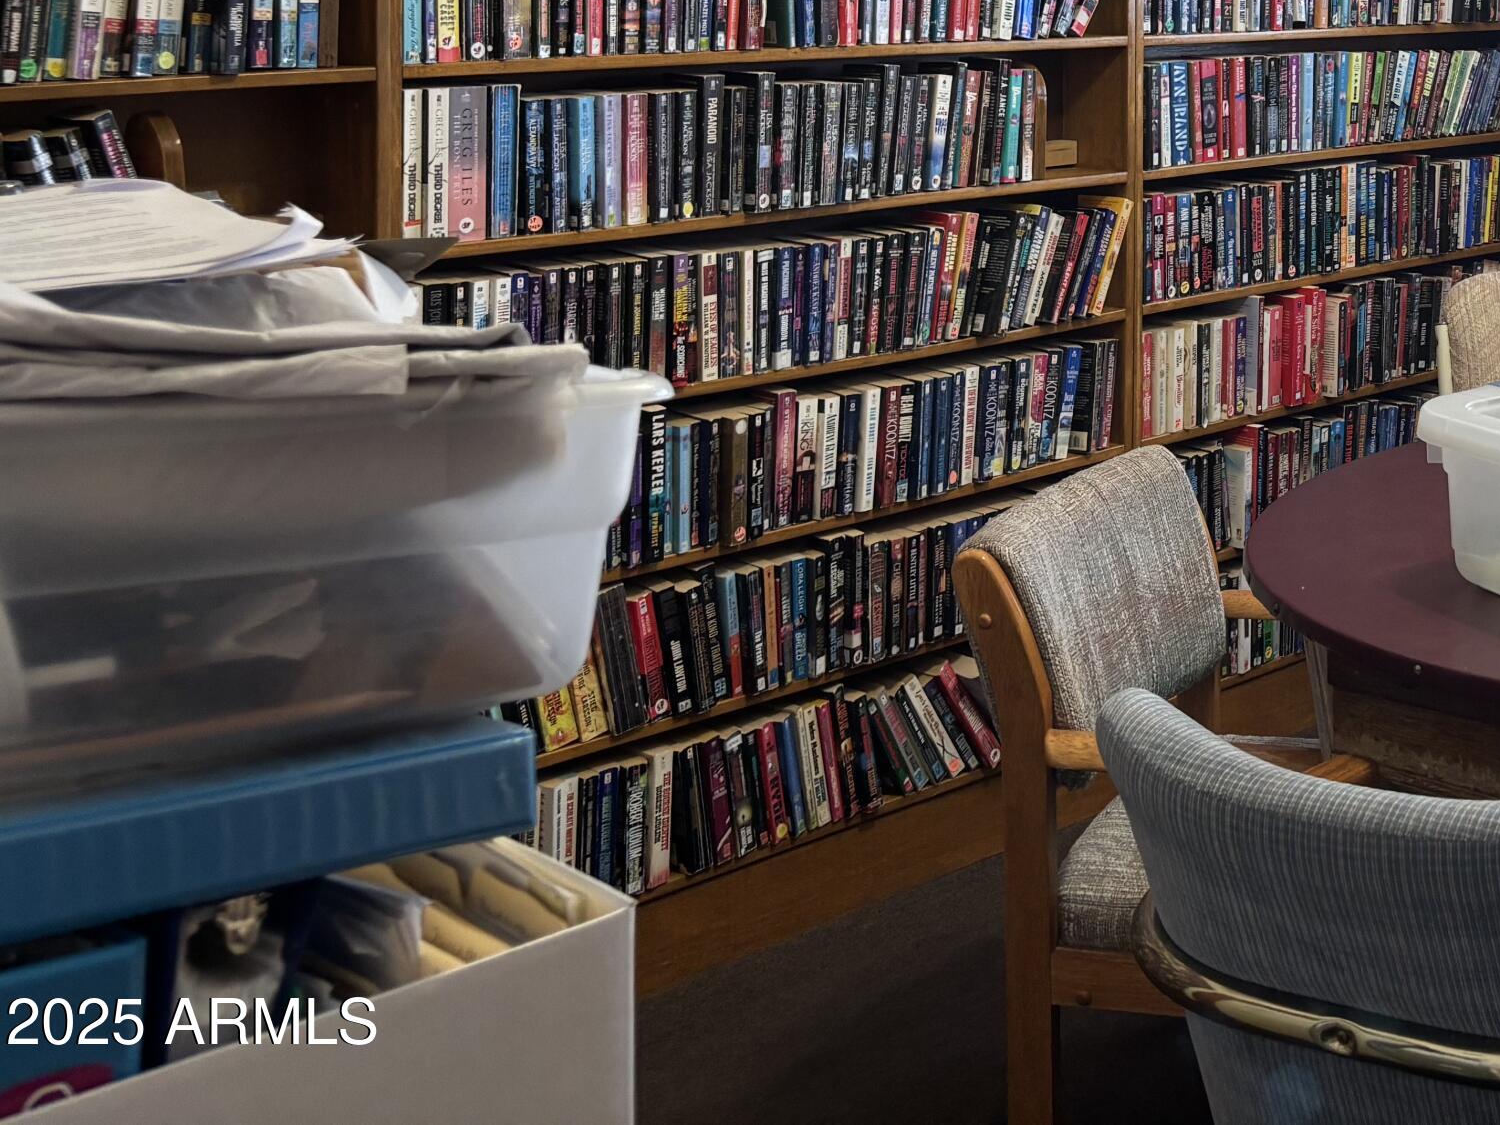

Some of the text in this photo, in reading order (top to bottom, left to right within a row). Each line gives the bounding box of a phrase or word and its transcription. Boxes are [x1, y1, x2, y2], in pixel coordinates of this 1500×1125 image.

[234, 3, 244, 47] THE CINDERELLA
[706, 97, 717, 144] PARANOID
[998, 91, 1006, 118] JANCE
[1174, 65, 1186, 149] AYN RAND
[434, 108, 444, 223] GREG ILES THIRD DEGREE
[461, 108, 472, 206] GREG ILES
[1031, 271, 1045, 313] MONSTER
[870, 298, 880, 343] EXPOSED
[983, 395, 998, 436] KOONTZ
[1042, 379, 1055, 419] KOONTZ
[651, 415, 665, 495] LARS KEPLER
[628, 792, 642, 859] ROBERT LUDLUM
